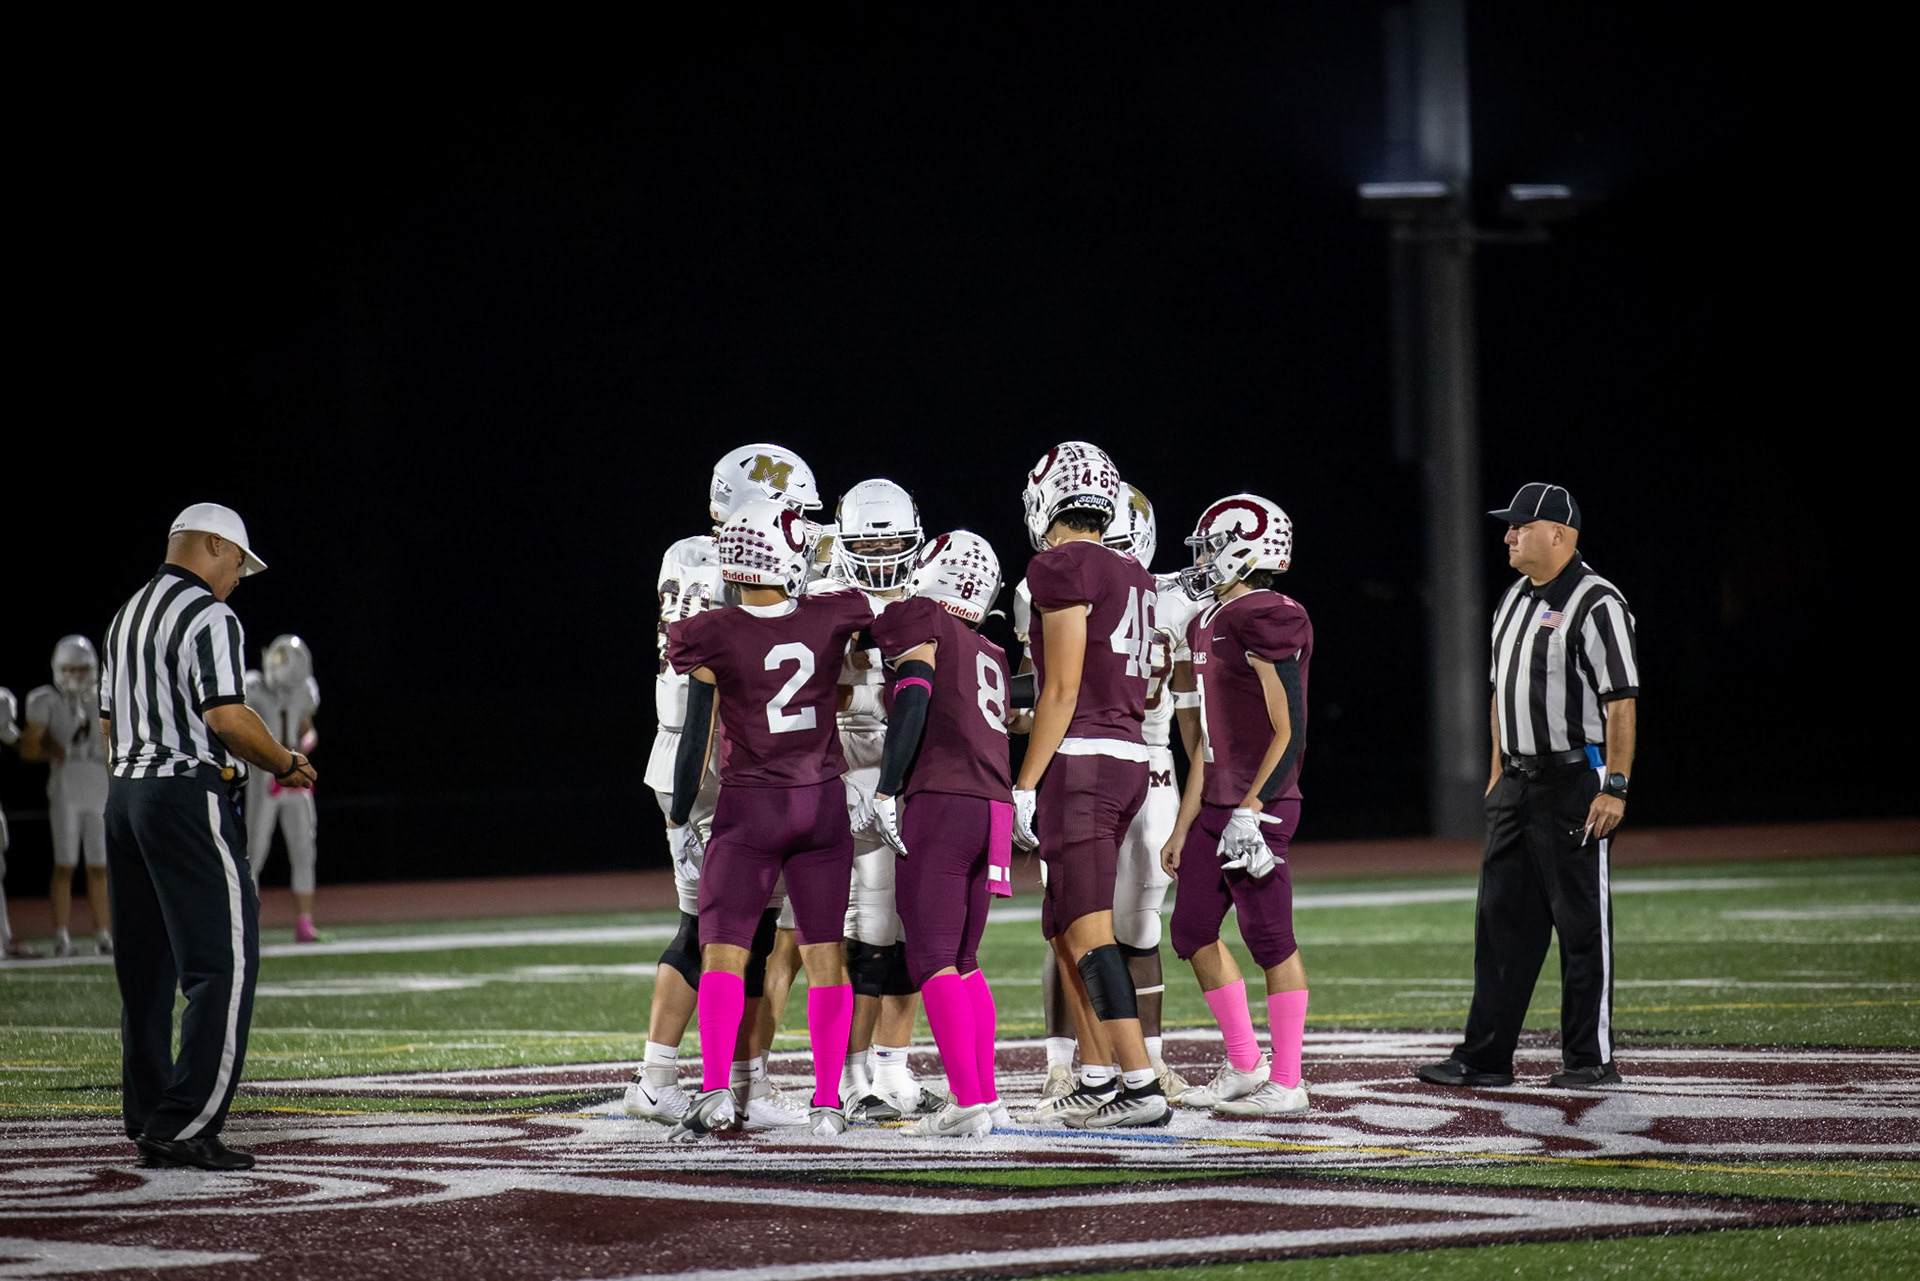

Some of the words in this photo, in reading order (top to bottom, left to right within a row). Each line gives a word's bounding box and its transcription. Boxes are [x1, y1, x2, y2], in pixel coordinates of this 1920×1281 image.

[748, 454, 794, 492] M
[1079, 494, 1109, 508] schutt
[735, 545, 744, 563] 2
[723, 570, 761, 583] Riddell
[961, 581, 974, 600] 8
[938, 599, 980, 621] Riddell
[764, 642, 816, 733] 2
[976, 651, 1008, 734] 8
[1150, 770, 1171, 788] M
